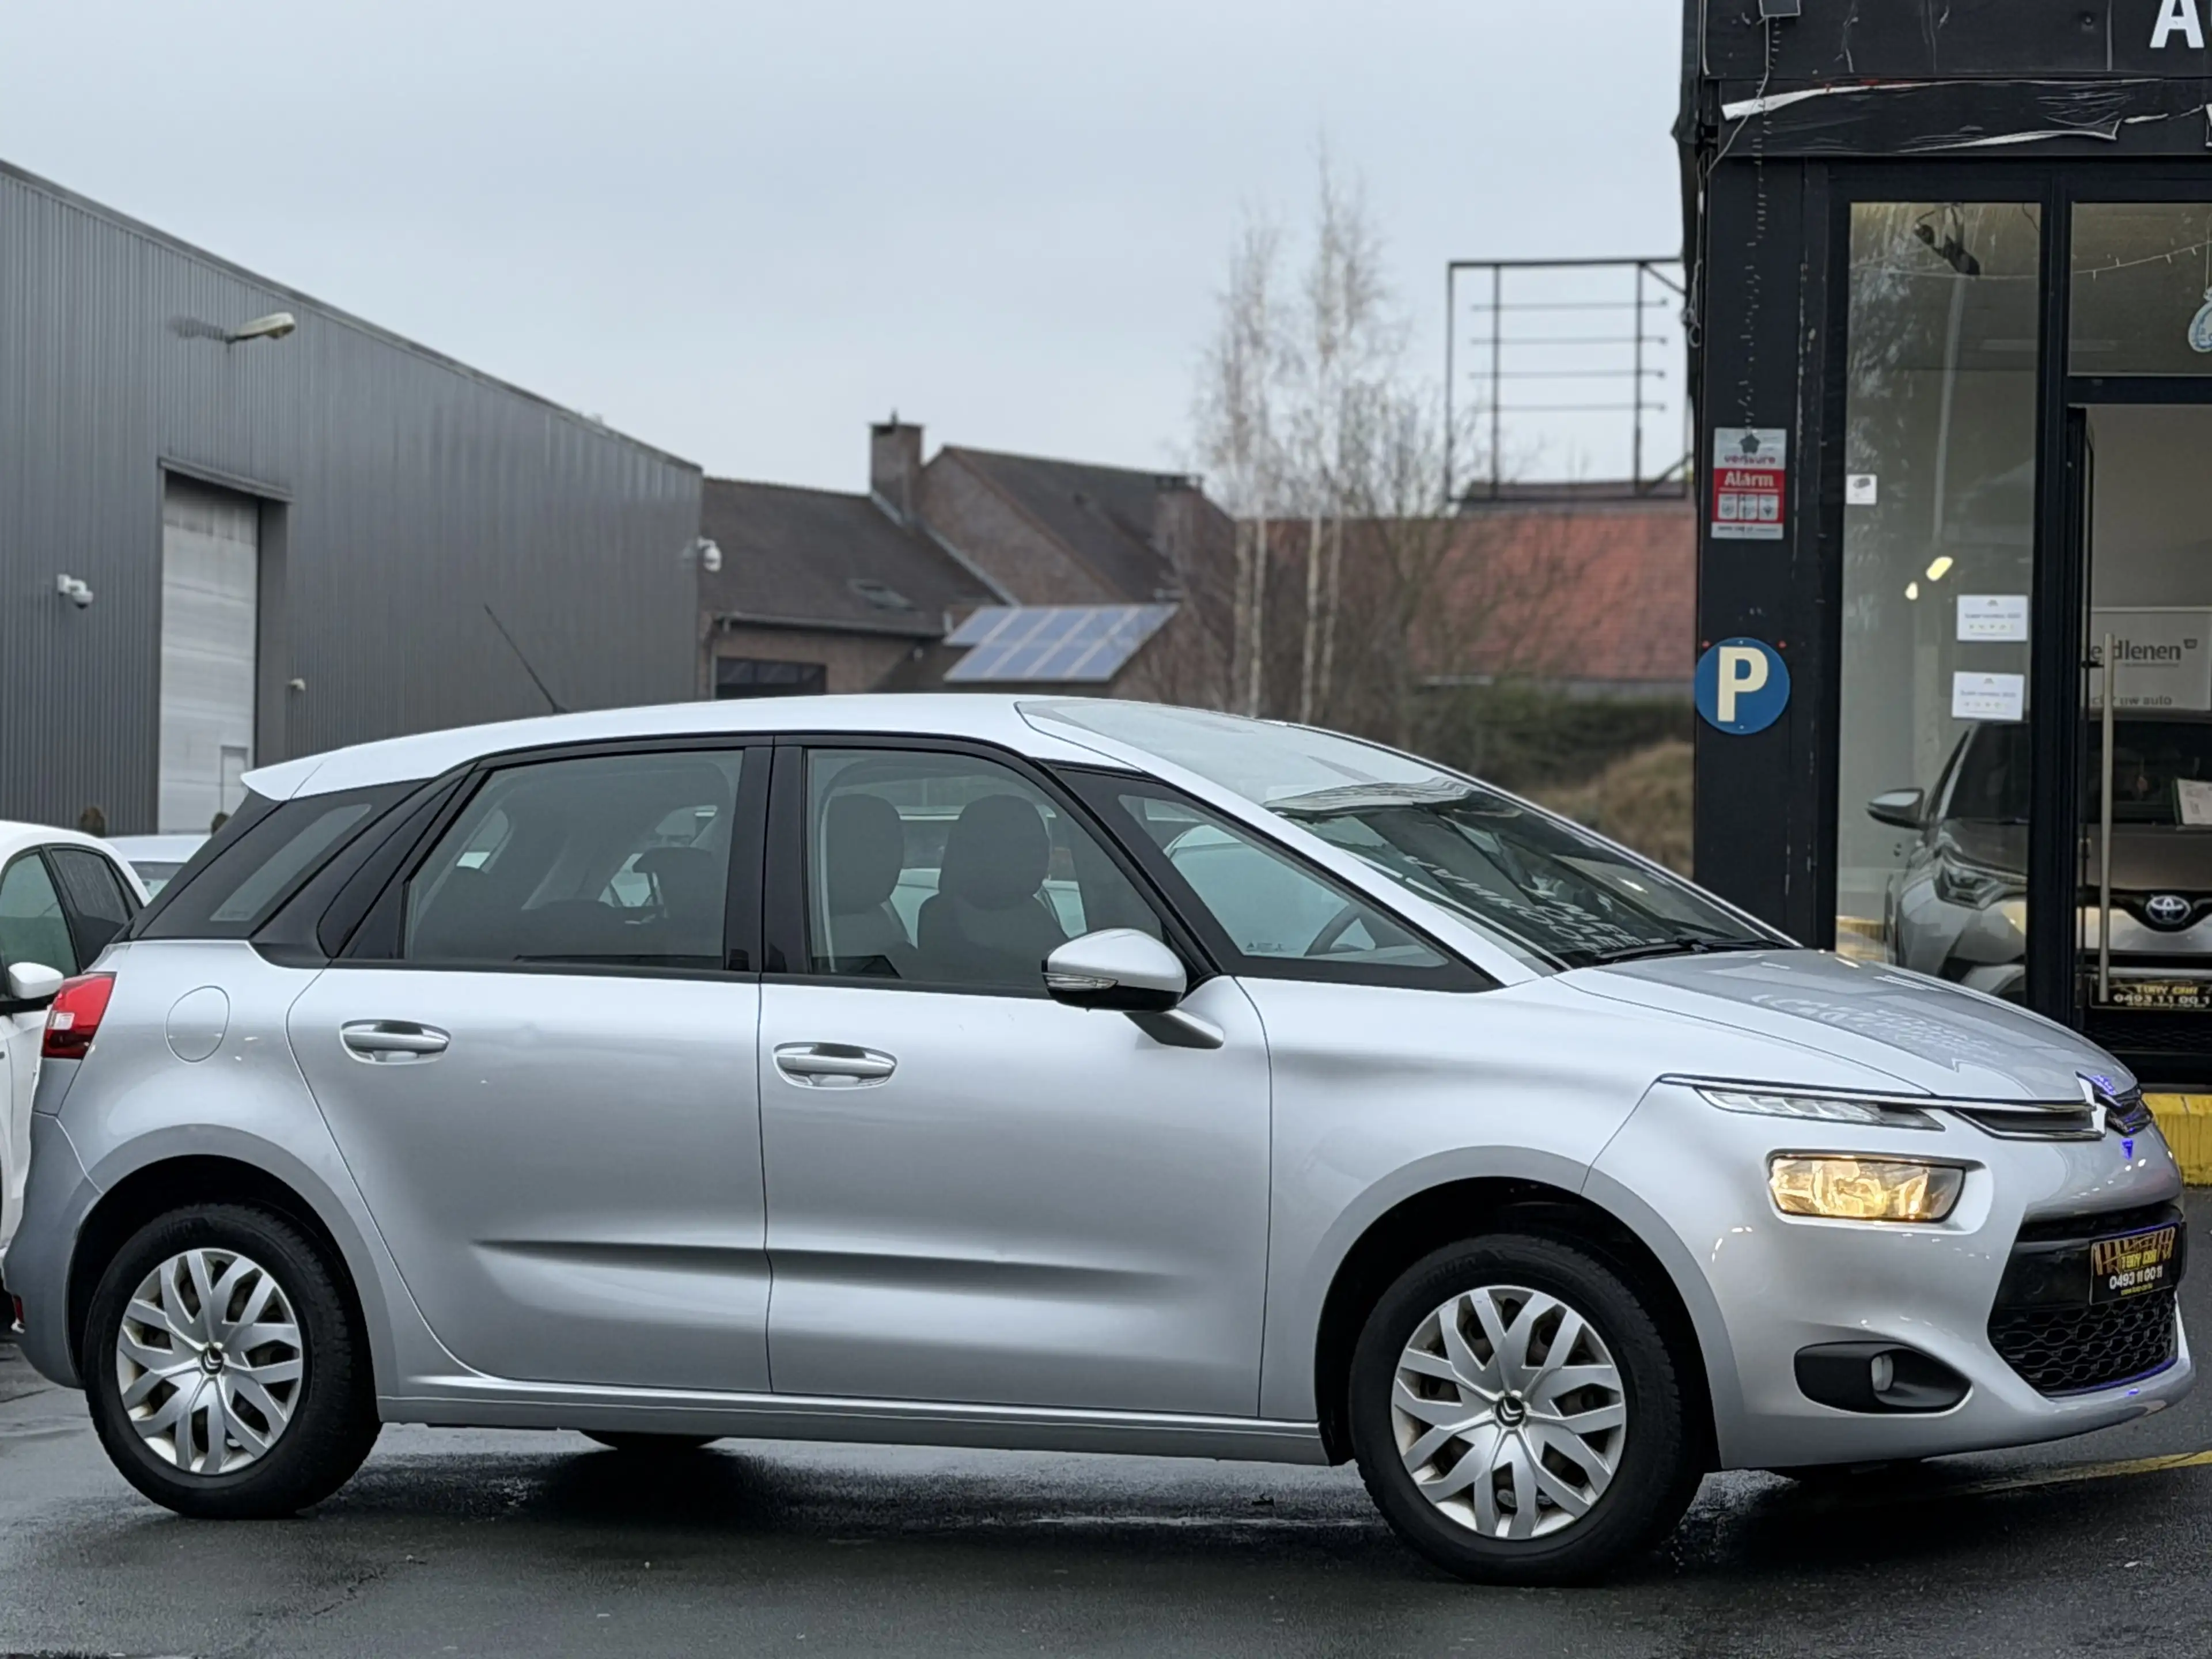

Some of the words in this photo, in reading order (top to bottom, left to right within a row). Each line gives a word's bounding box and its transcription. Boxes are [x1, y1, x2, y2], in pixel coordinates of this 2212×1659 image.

[1725, 471, 1774, 487] Alarm
[1718, 646, 1768, 722] P
[2109, 1271, 2135, 1290] 0493
